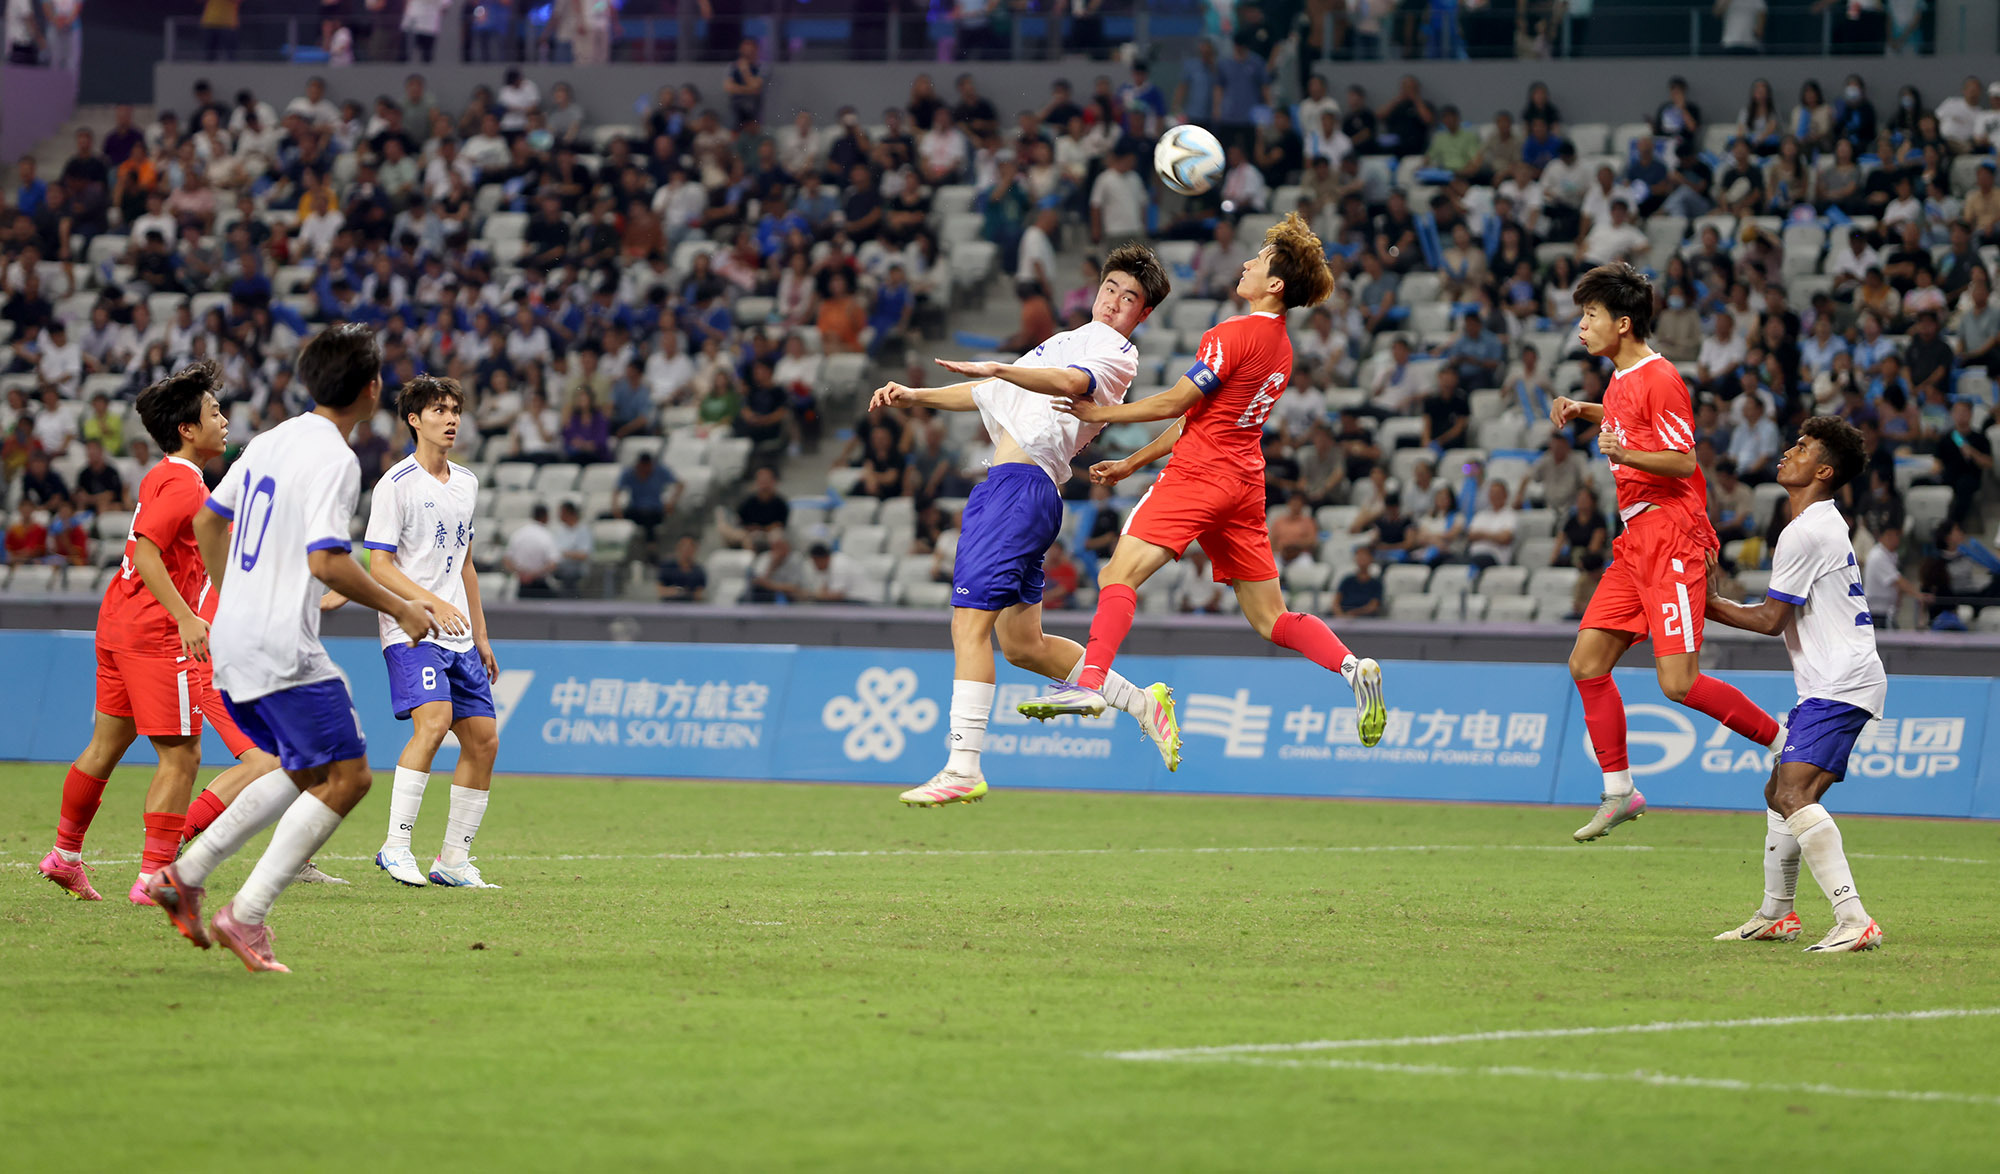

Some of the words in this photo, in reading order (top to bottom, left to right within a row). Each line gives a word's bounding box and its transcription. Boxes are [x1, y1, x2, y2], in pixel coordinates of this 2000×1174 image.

[1193, 368, 1216, 387] C
[1234, 371, 1285, 429] 6
[233, 467, 276, 573] 10
[433, 520, 466, 550] 廣東
[1662, 602, 1682, 637] 2
[421, 666, 437, 691] 8
[551, 676, 769, 719] 中国南方航空
[542, 718, 619, 745] CHINA
[625, 719, 762, 749] SOUTHERN
[1020, 731, 1112, 758] unicom
[1278, 745, 1332, 760] CHINA
[1335, 746, 1429, 763] SOUTHERN
[1431, 748, 1495, 766] POWER
[1496, 751, 1541, 767] GRID
[1848, 752, 1960, 778] ROUP
